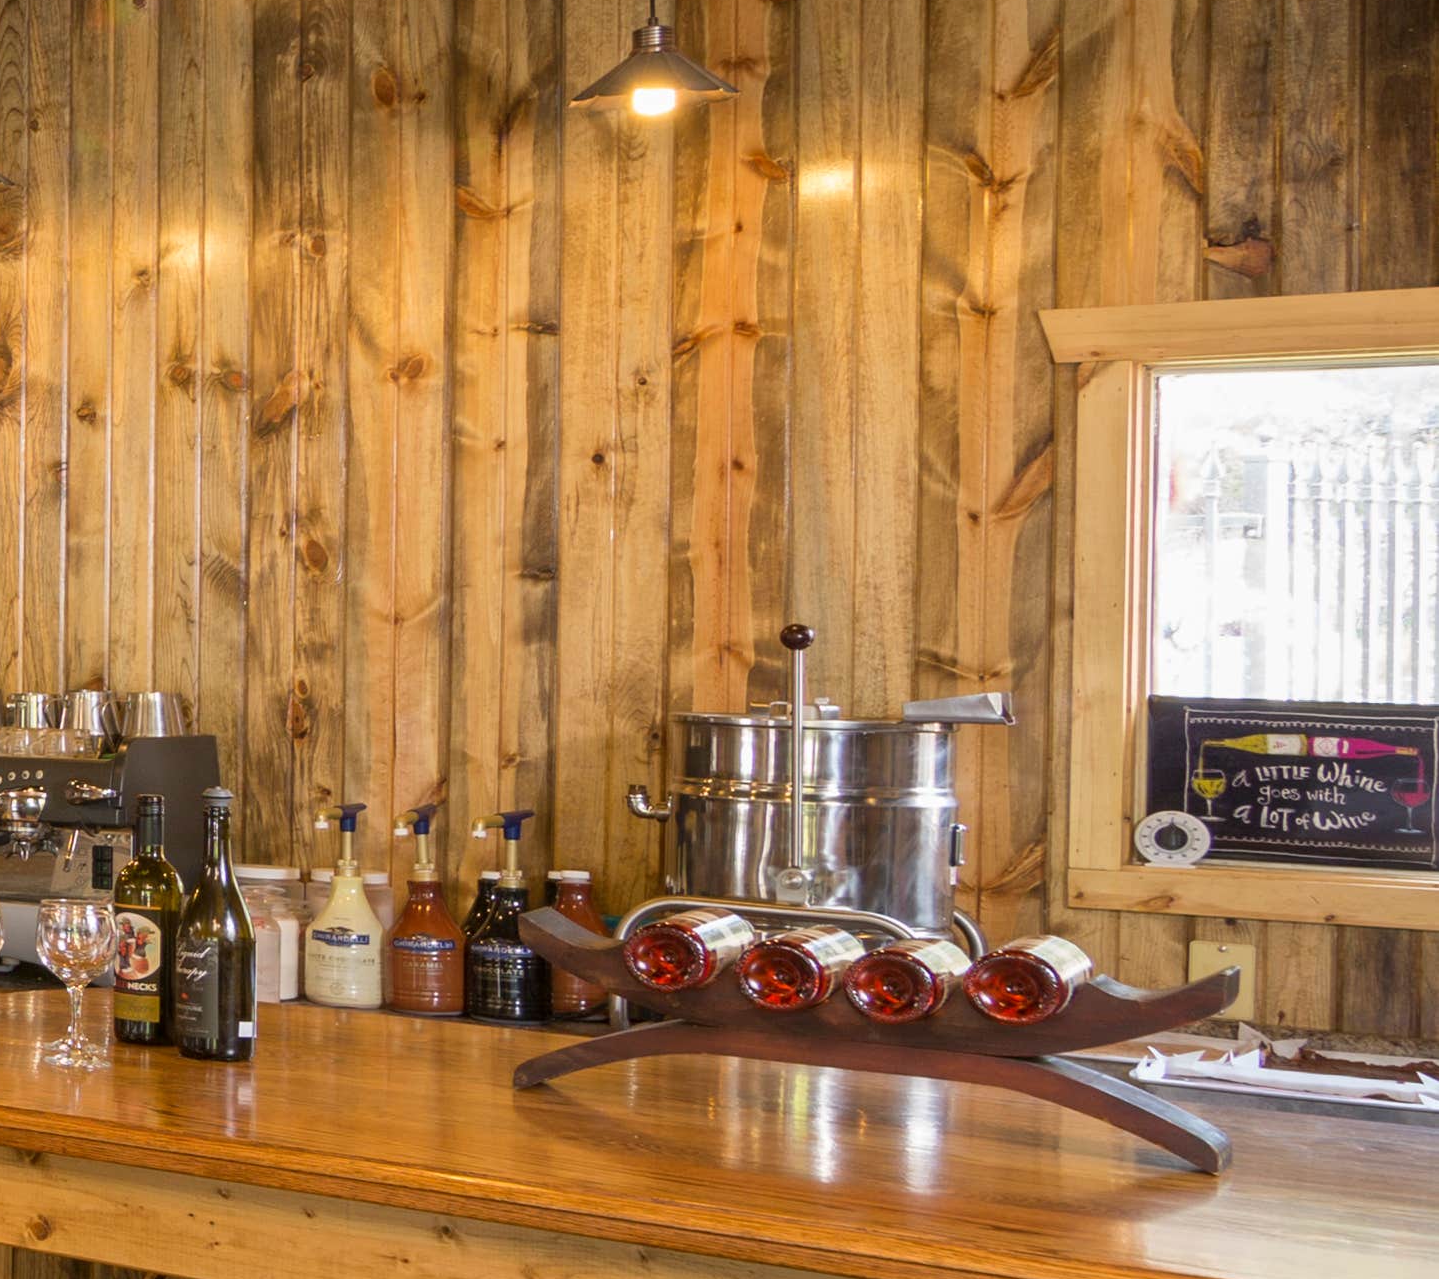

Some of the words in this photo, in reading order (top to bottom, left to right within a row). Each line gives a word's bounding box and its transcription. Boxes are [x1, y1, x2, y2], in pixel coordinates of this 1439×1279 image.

[1255, 765, 1312, 782] LITTLE
[1316, 762, 1387, 793] Whine
[1257, 786, 1301, 804] goes
[1307, 787, 1346, 805] with
[1260, 806, 1295, 831] LOT
[1296, 812, 1311, 830] of
[1313, 811, 1376, 831] Wine
